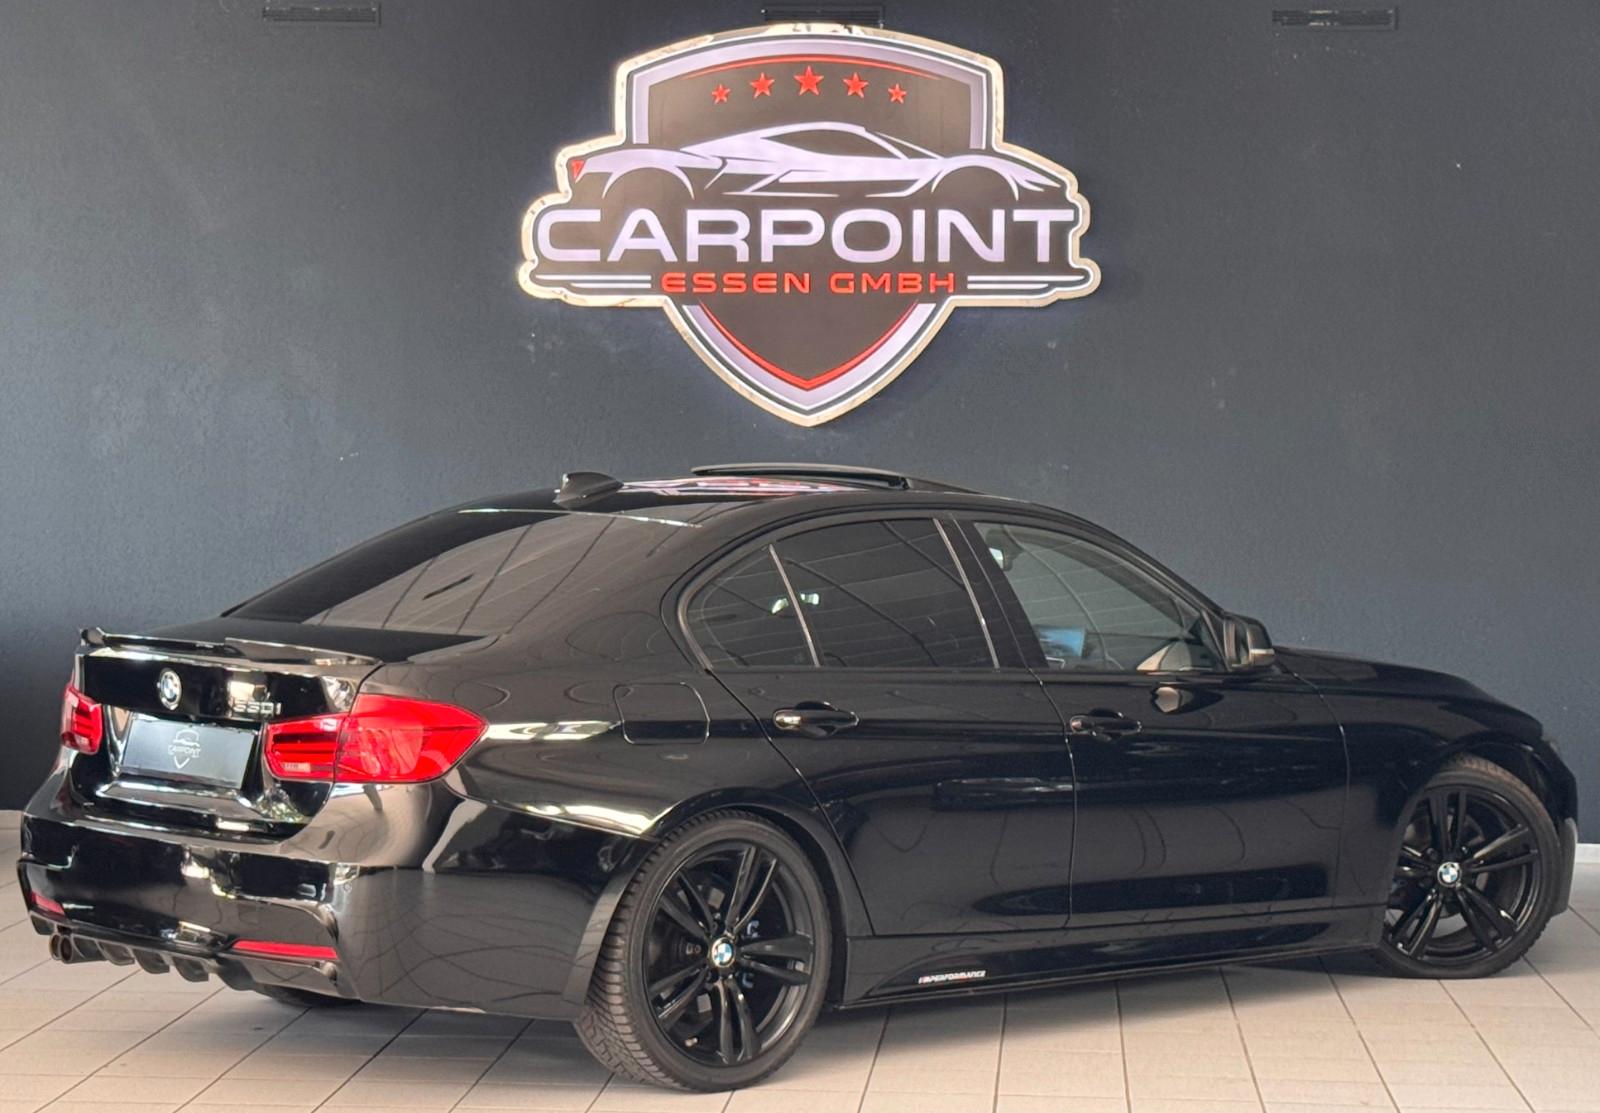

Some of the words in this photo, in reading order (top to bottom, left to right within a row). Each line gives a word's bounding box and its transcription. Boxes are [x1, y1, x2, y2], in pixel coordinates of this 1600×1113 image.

[538, 208, 1074, 262] CARPOINT
[661, 272, 811, 294] ESSEN
[829, 272, 956, 294] GMBH
